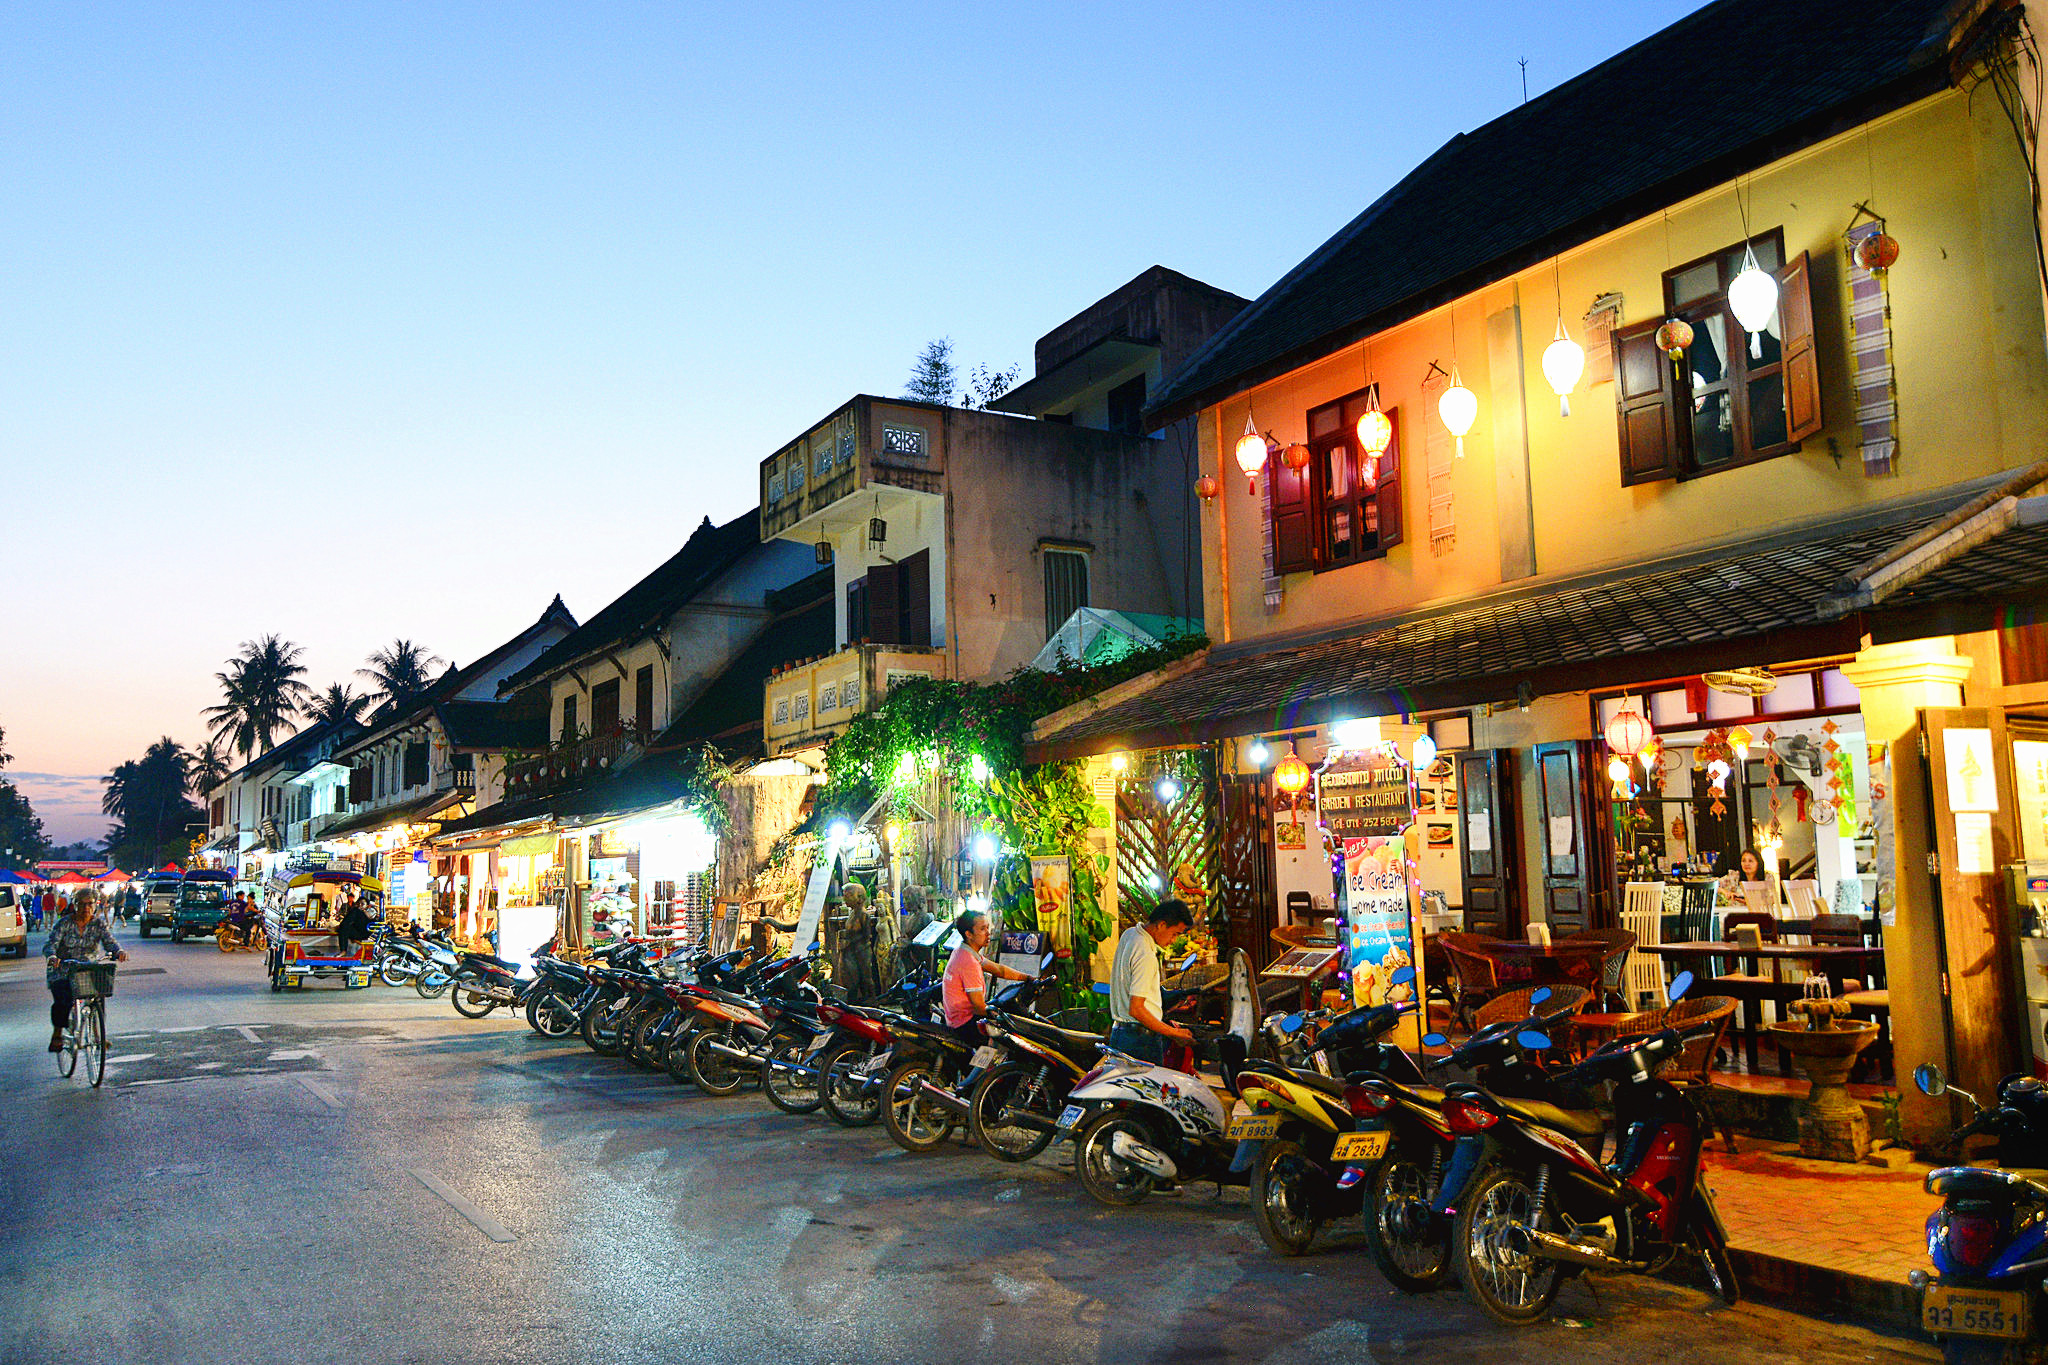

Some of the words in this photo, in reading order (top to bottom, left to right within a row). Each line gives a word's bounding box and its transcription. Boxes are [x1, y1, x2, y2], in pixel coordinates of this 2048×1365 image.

[1321, 796, 1351, 811] GARDEN
[1355, 792, 1406, 808] RESTAURANT
[1363, 817, 1379, 827] 252
[1380, 816, 1397, 826] 583
[1345, 838, 1367, 857] Here
[1349, 871, 1365, 891] Ice
[1368, 871, 1403, 891] Cream
[1351, 899, 1378, 916] Home
[1379, 892, 1404, 913] made
[1352, 1144, 1381, 1157] 2623
